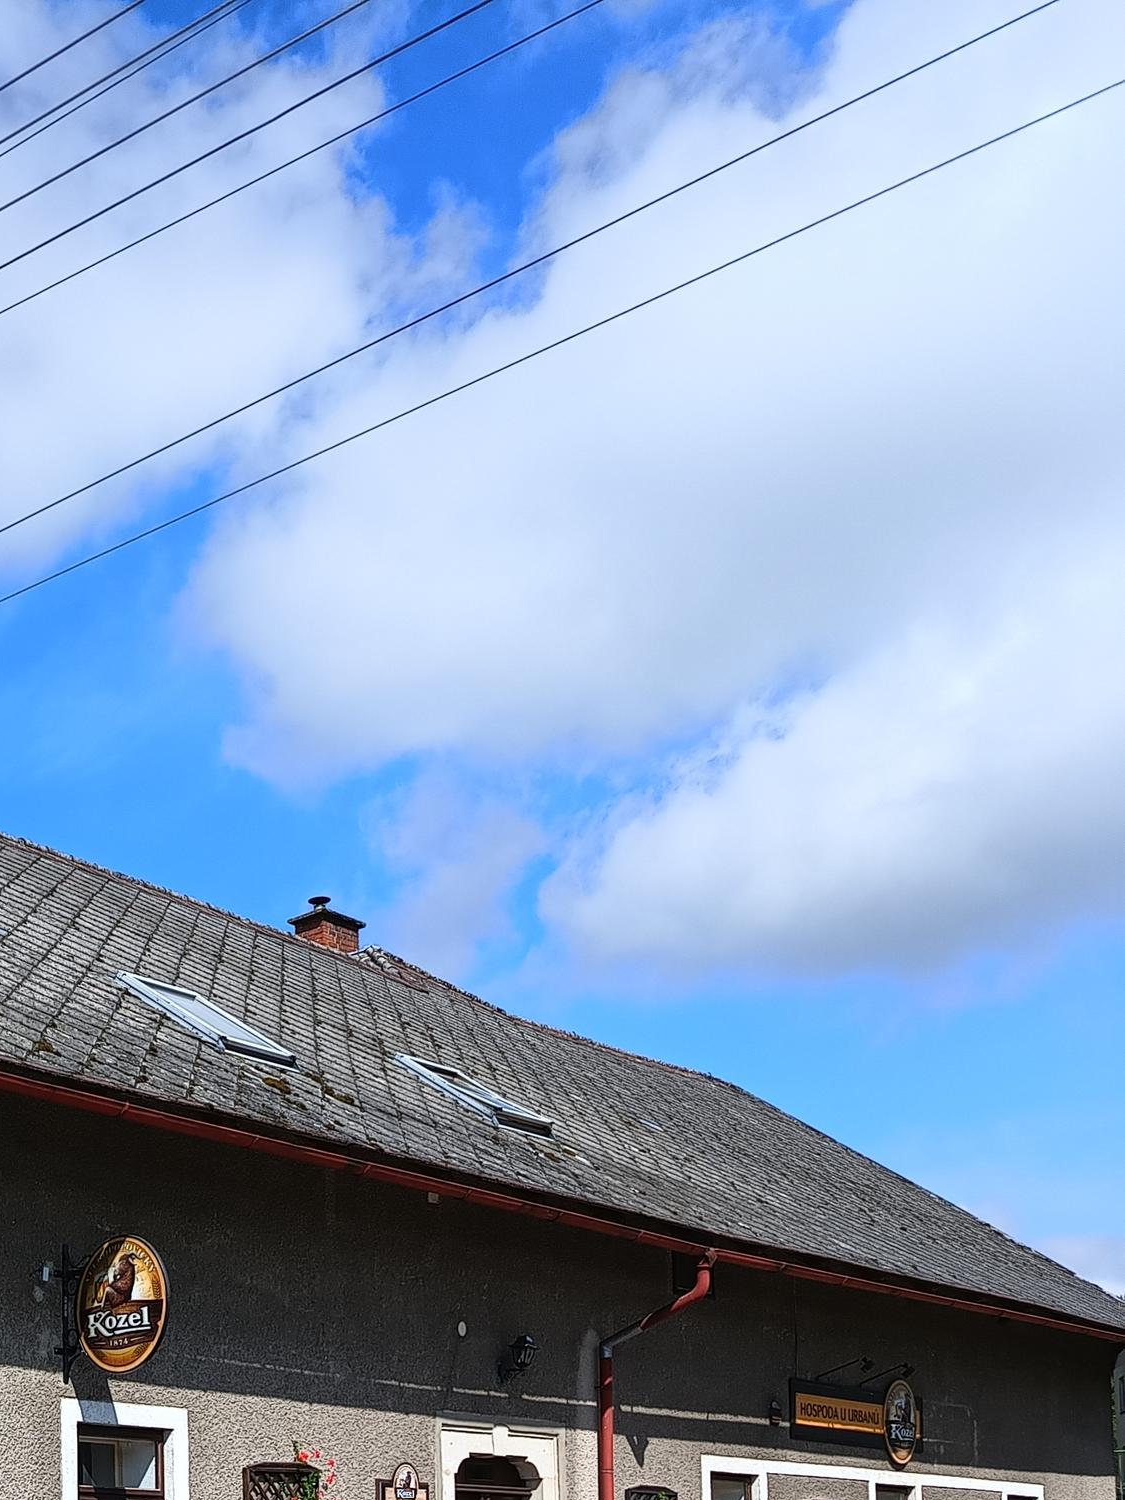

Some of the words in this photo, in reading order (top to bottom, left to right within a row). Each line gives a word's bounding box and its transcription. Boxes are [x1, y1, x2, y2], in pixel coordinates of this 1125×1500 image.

[87, 1306, 151, 1338] Kozel
[800, 1402, 839, 1420] HOSPODA
[840, 1408, 847, 1421] U
